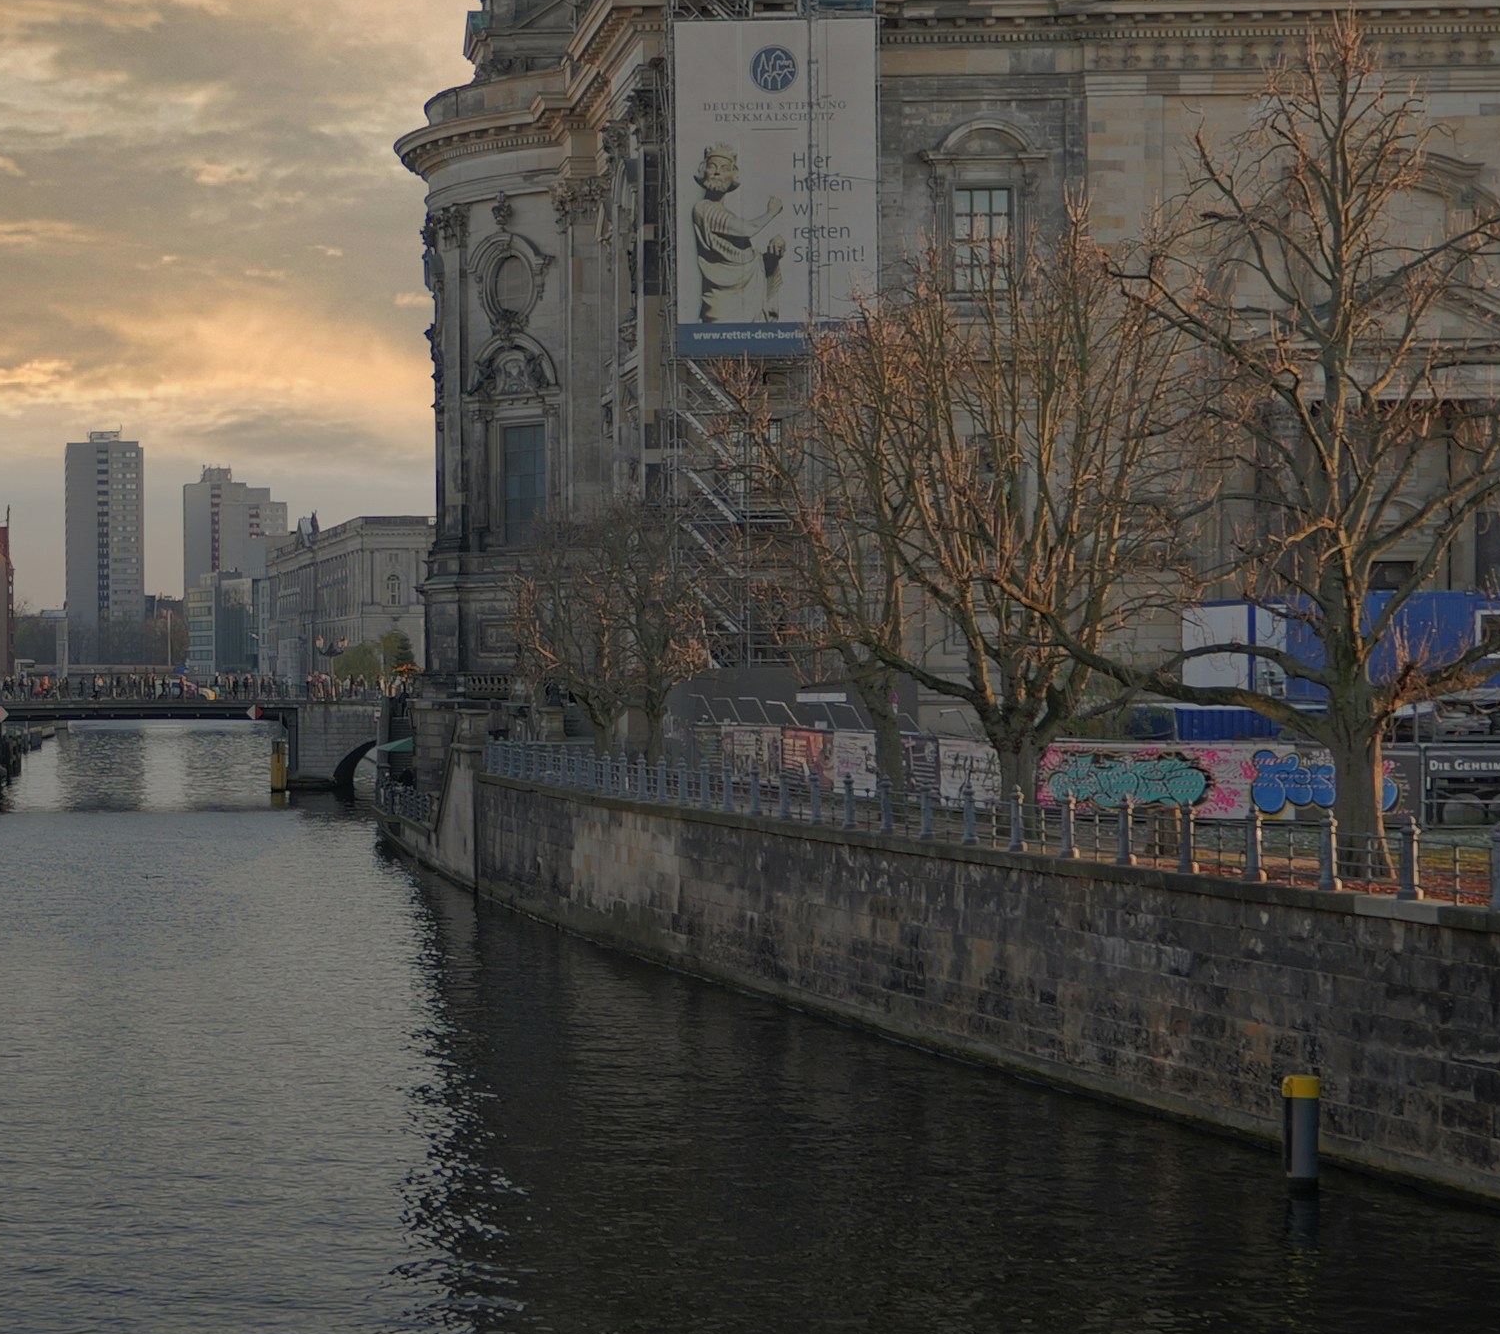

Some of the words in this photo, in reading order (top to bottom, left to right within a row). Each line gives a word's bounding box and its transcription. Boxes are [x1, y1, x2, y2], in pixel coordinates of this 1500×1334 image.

[703, 102, 773, 111] DEUTSCHE
[779, 101, 847, 111] STIFUNG
[793, 152, 832, 168] Her
[793, 203, 822, 215] wr
[828, 245, 865, 262] mit!
[1429, 760, 1451, 771] DIE
